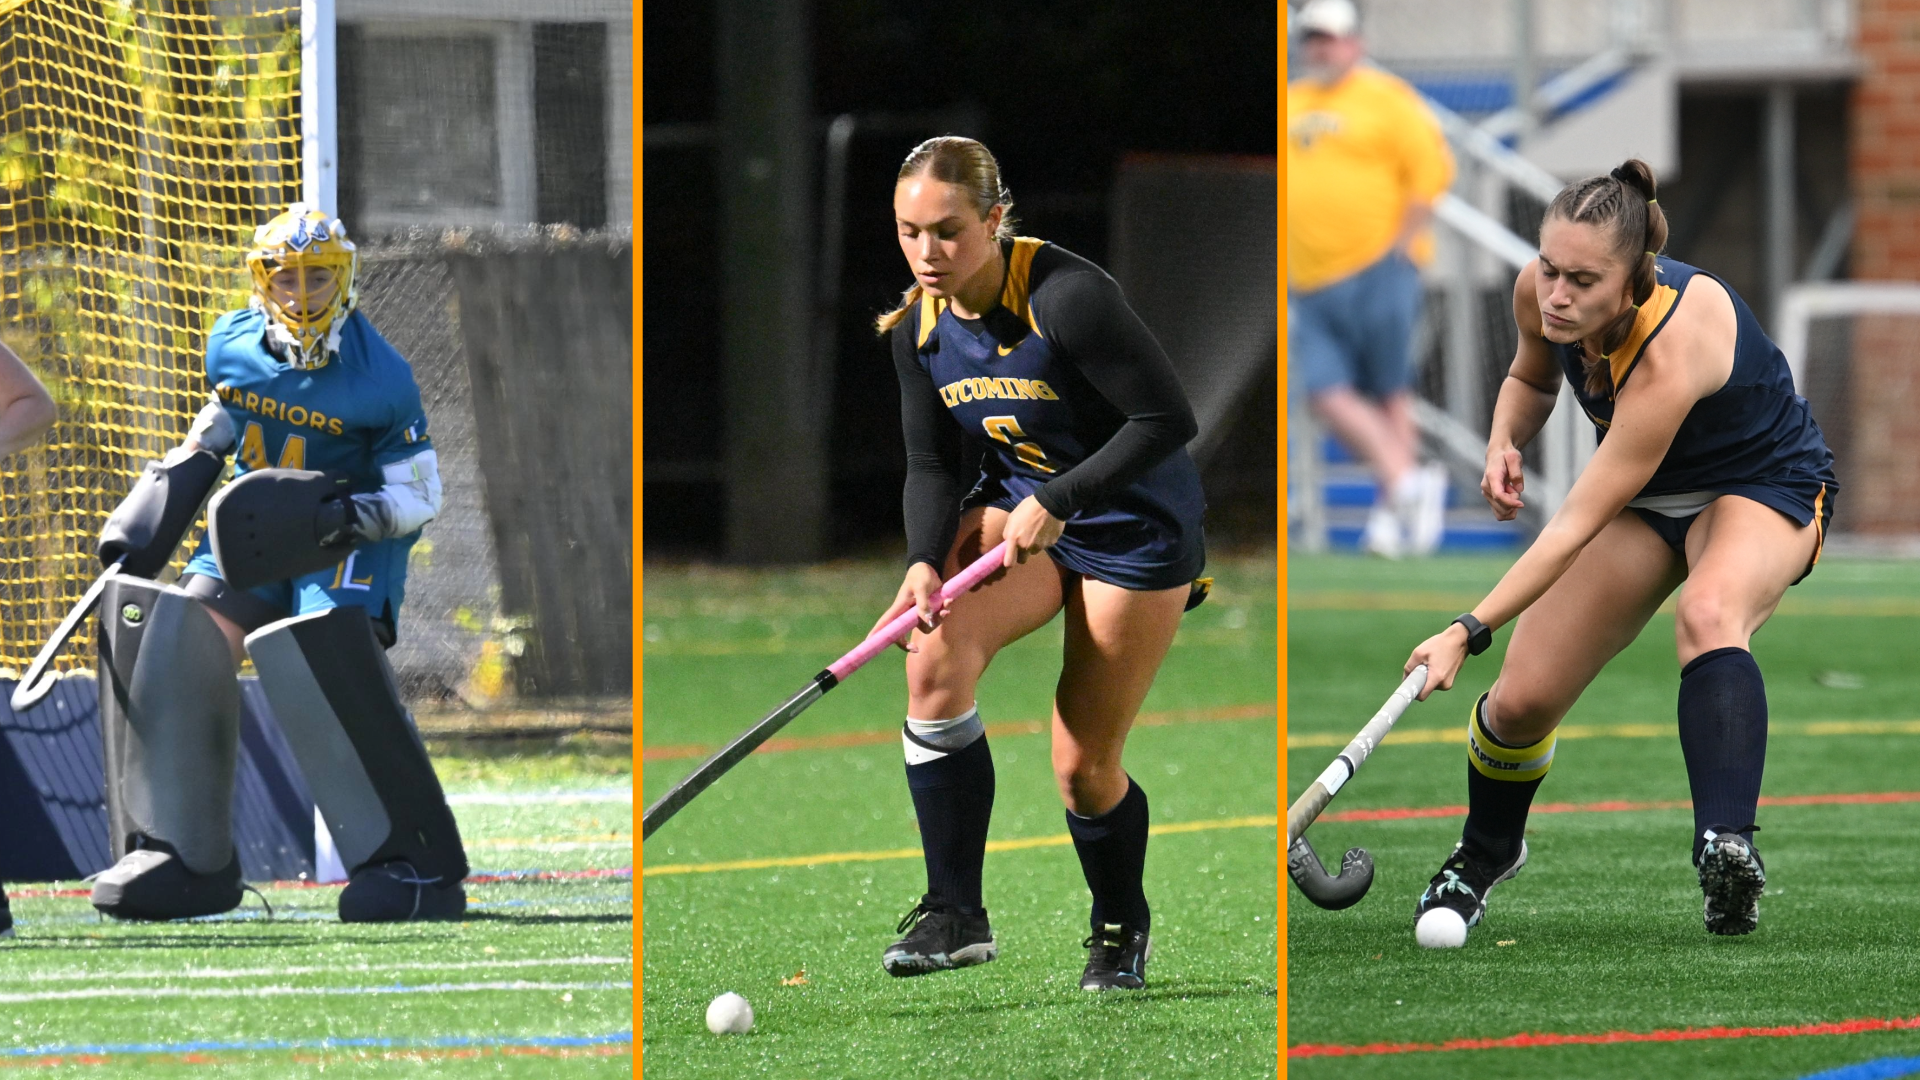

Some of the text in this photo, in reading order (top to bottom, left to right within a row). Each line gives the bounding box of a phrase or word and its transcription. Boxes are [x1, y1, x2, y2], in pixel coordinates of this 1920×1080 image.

[939, 376, 1060, 409] LYCOMING
[217, 385, 344, 436] WARRIORS
[1470, 736, 1521, 771] CAPTAIN
